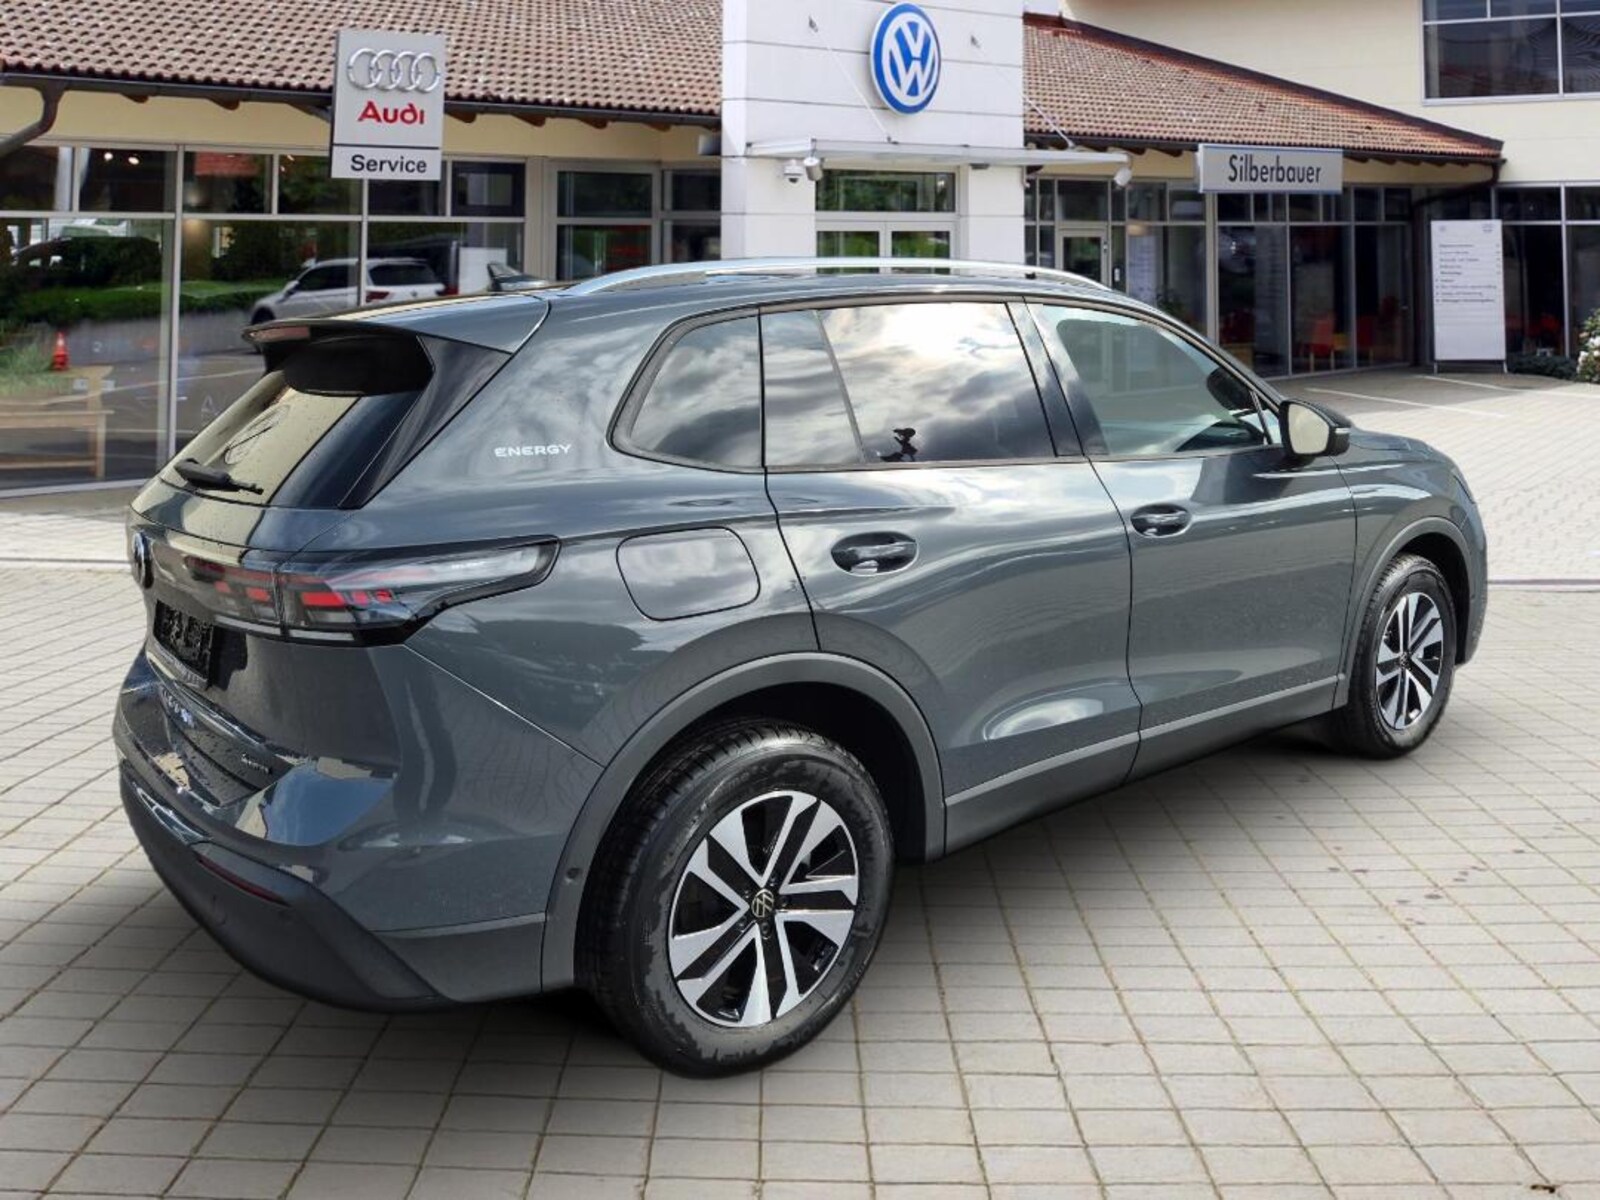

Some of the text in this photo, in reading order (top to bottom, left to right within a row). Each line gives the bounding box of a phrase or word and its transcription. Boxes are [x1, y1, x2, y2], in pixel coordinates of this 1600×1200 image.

[358, 100, 425, 125] Audi
[350, 153, 428, 174] Service
[1228, 153, 1321, 183] Silberbauer
[494, 443, 572, 458] ENERGY
